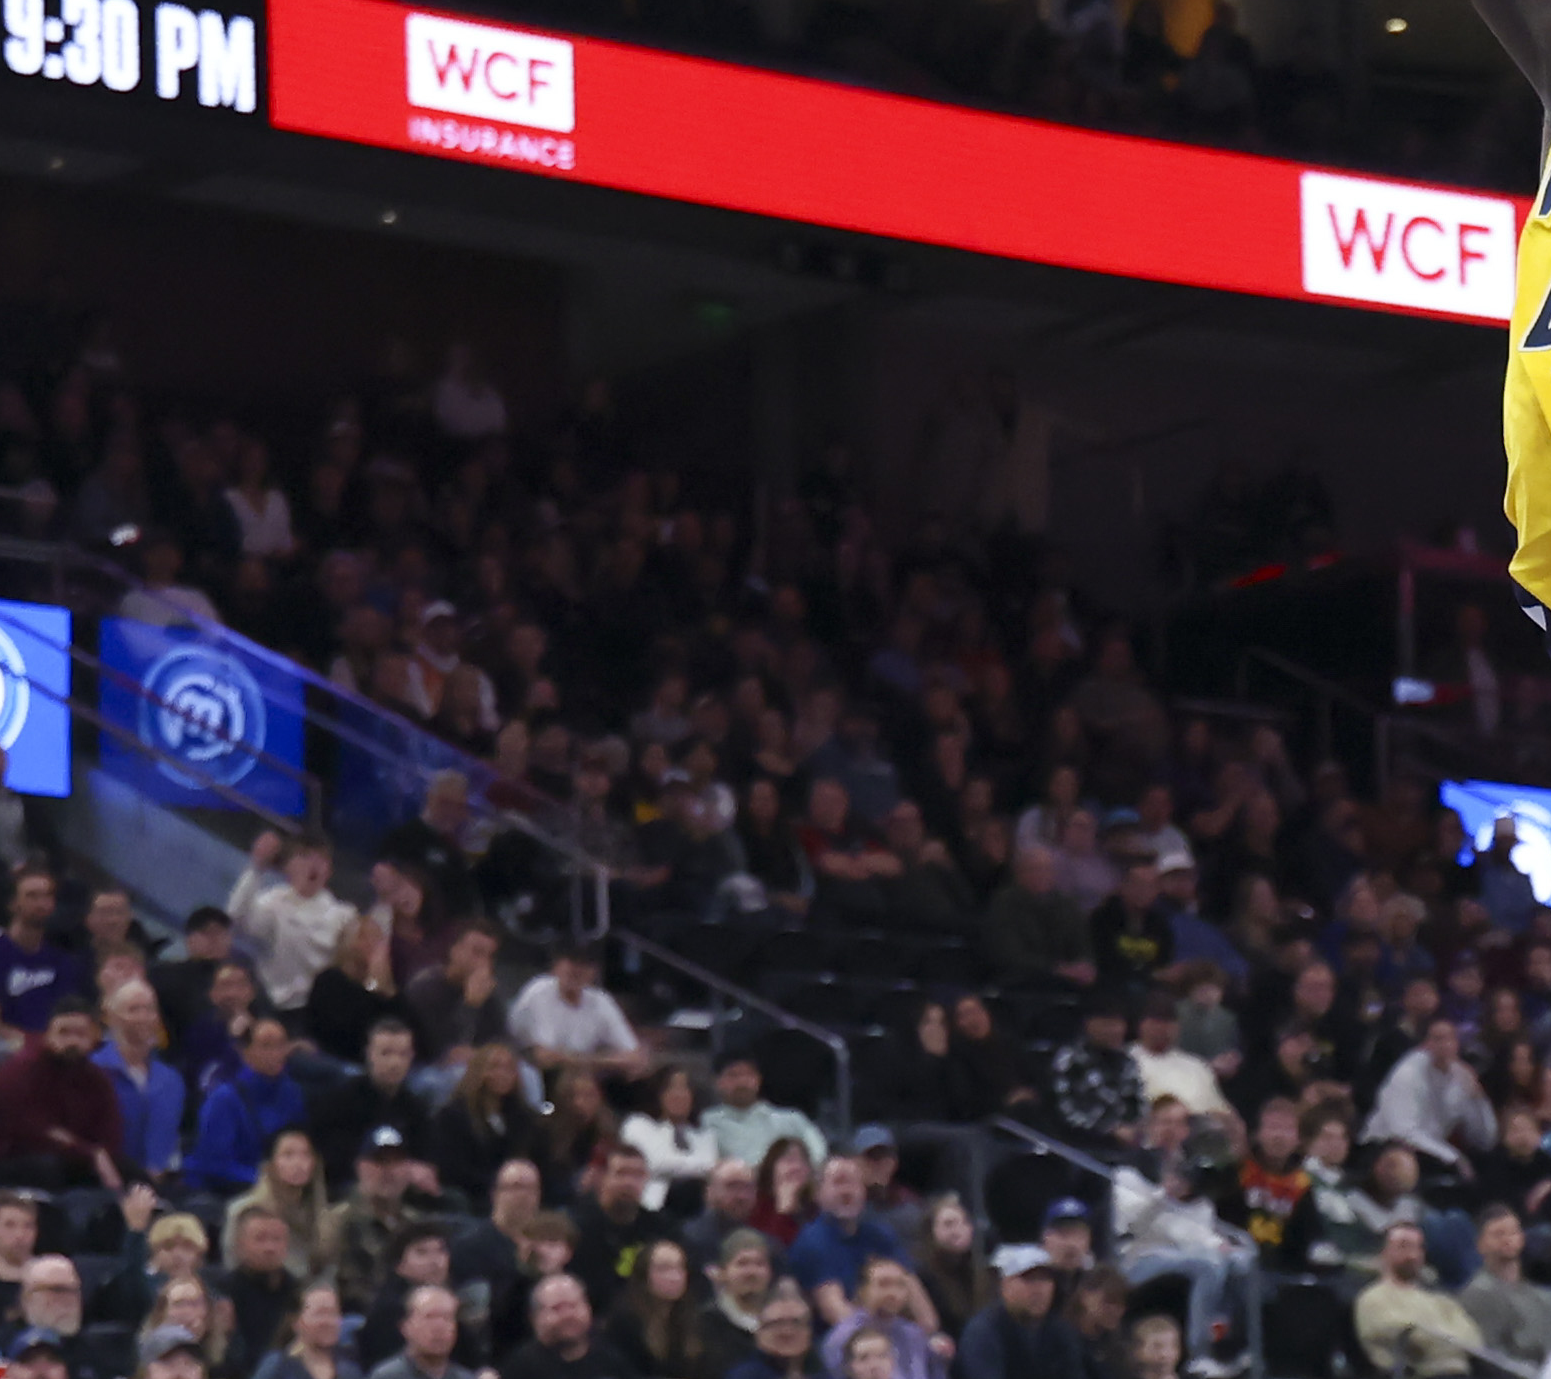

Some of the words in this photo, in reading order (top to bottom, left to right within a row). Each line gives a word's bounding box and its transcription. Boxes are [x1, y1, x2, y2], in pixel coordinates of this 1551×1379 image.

[154, 0, 257, 114] PM
[425, 37, 557, 107] WCF
[406, 115, 577, 171] INSURANCE
[1327, 202, 1492, 287] WCF
